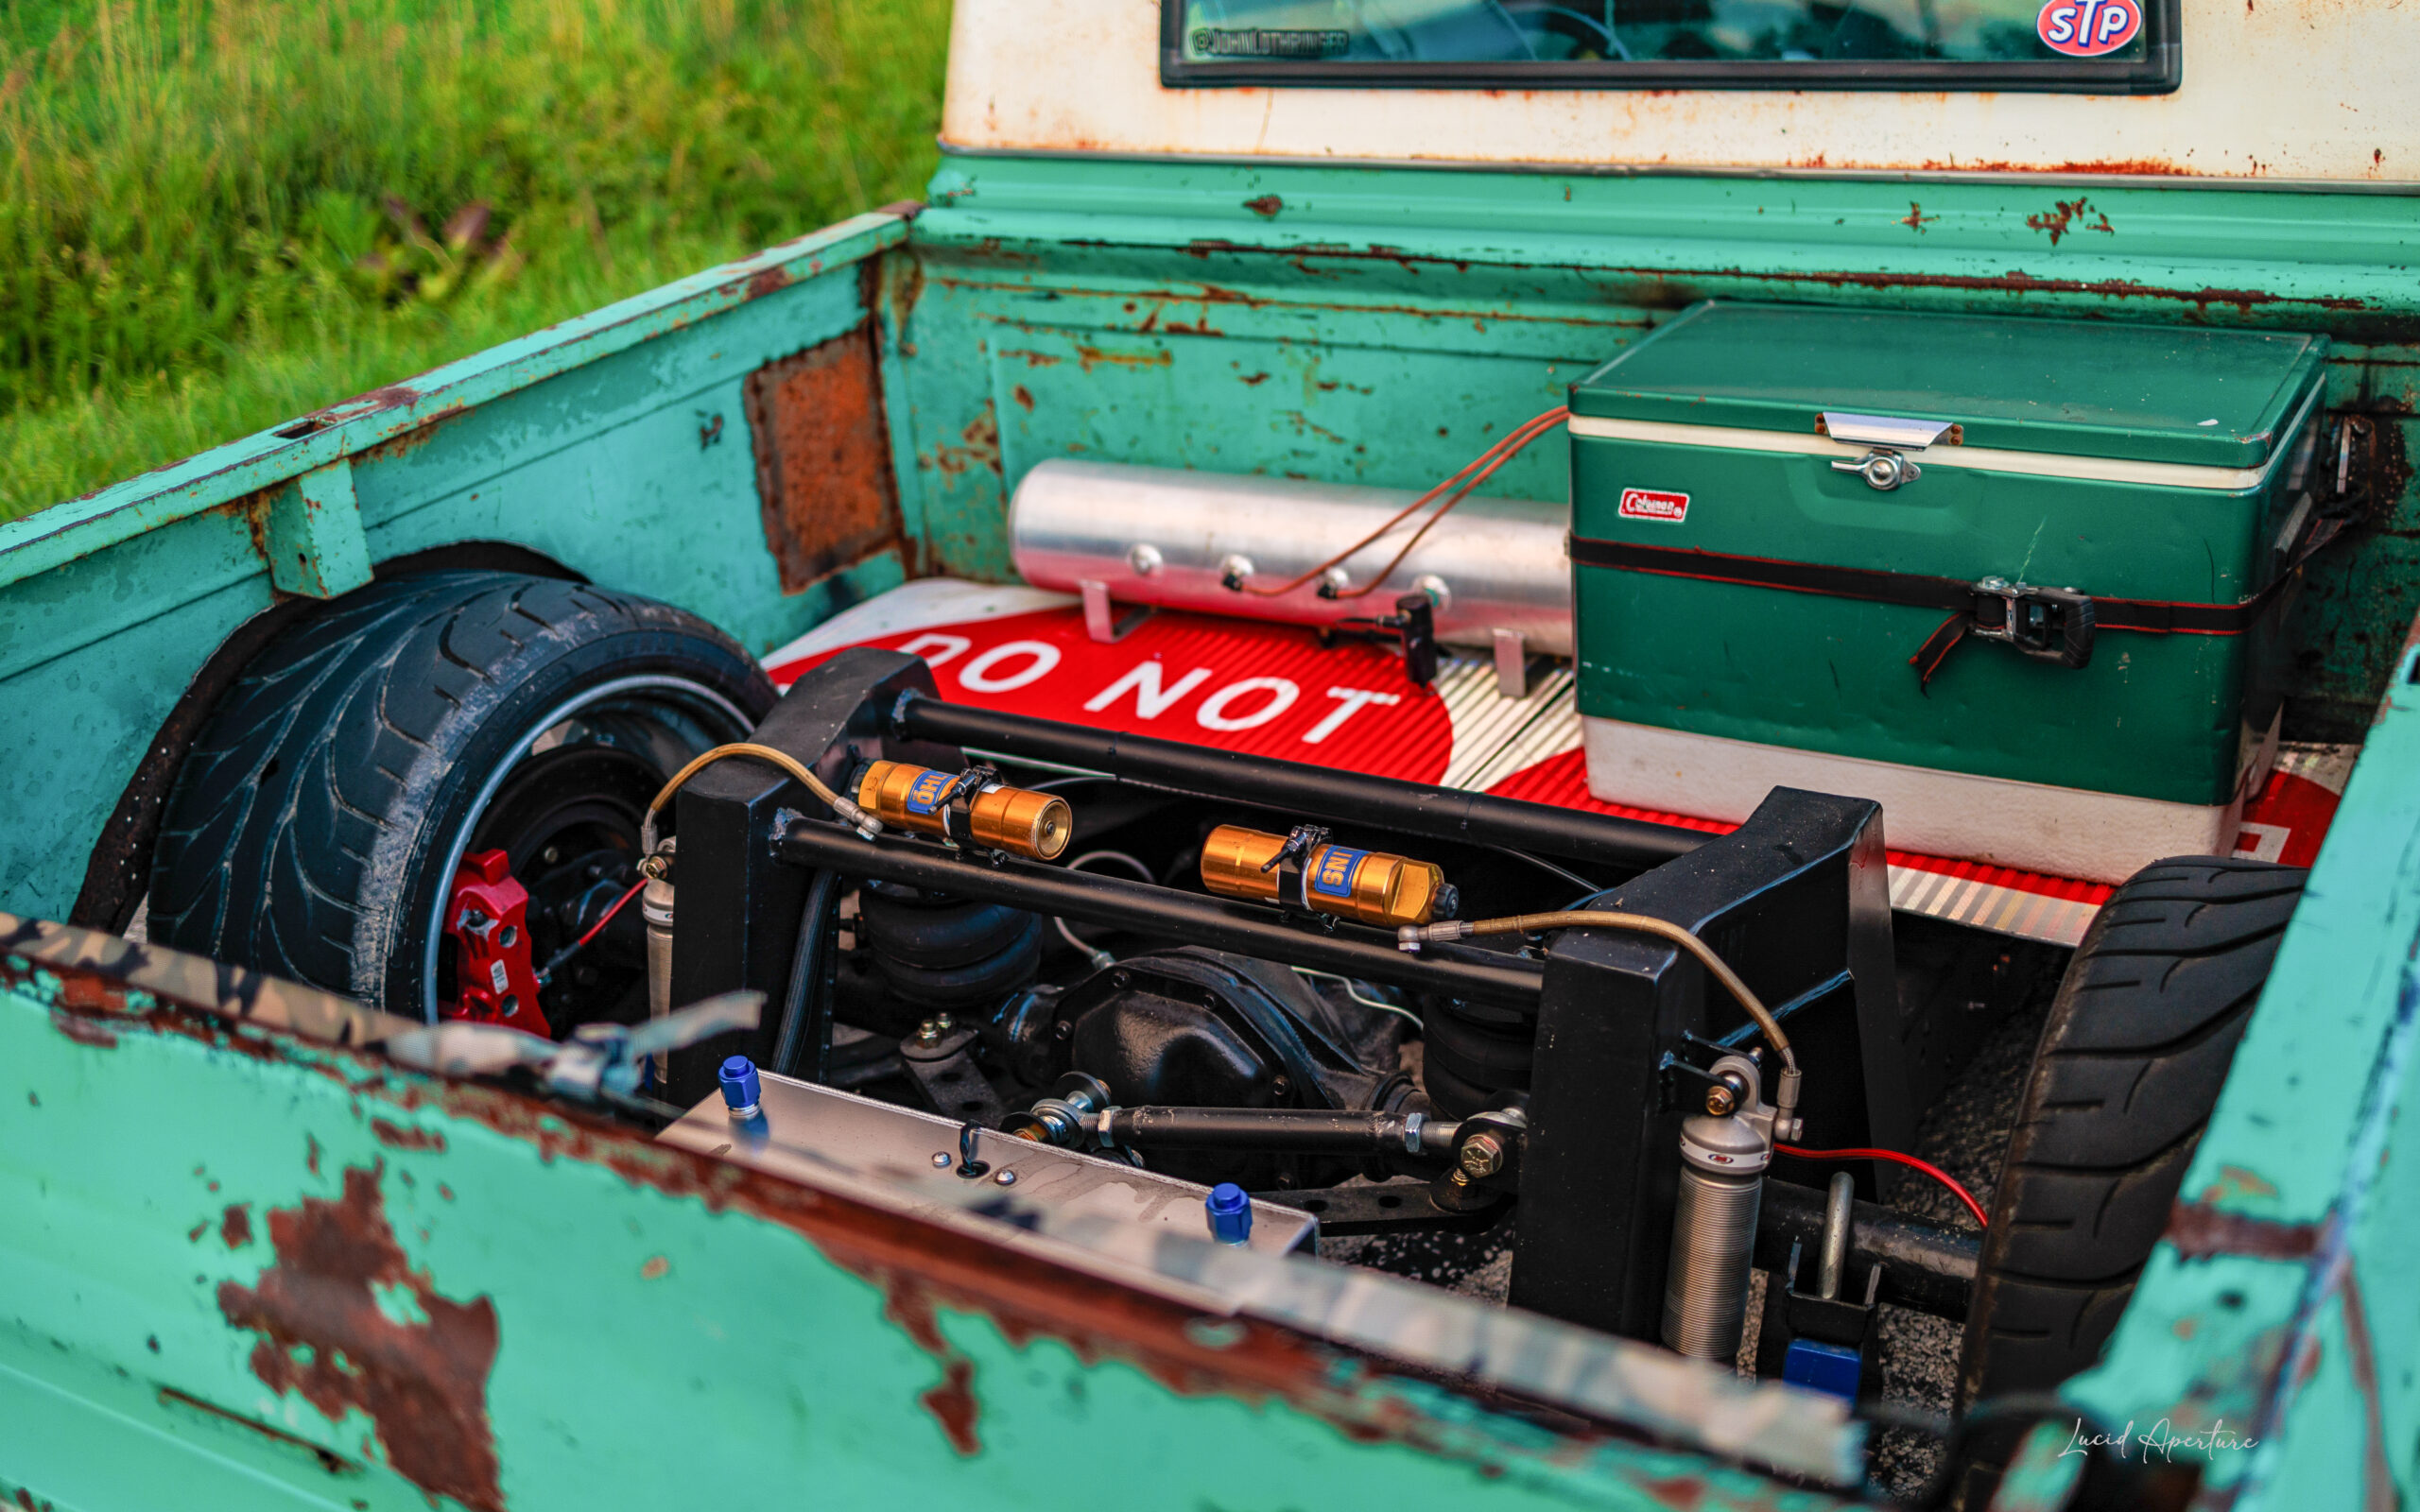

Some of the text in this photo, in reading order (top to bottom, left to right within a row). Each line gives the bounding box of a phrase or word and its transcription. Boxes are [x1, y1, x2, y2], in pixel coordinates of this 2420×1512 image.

[2048, 0, 2129, 46] STP
[896, 632, 1401, 745] DO NOT
[912, 774, 949, 805] ÖHL
[1322, 850, 1353, 886] INS
